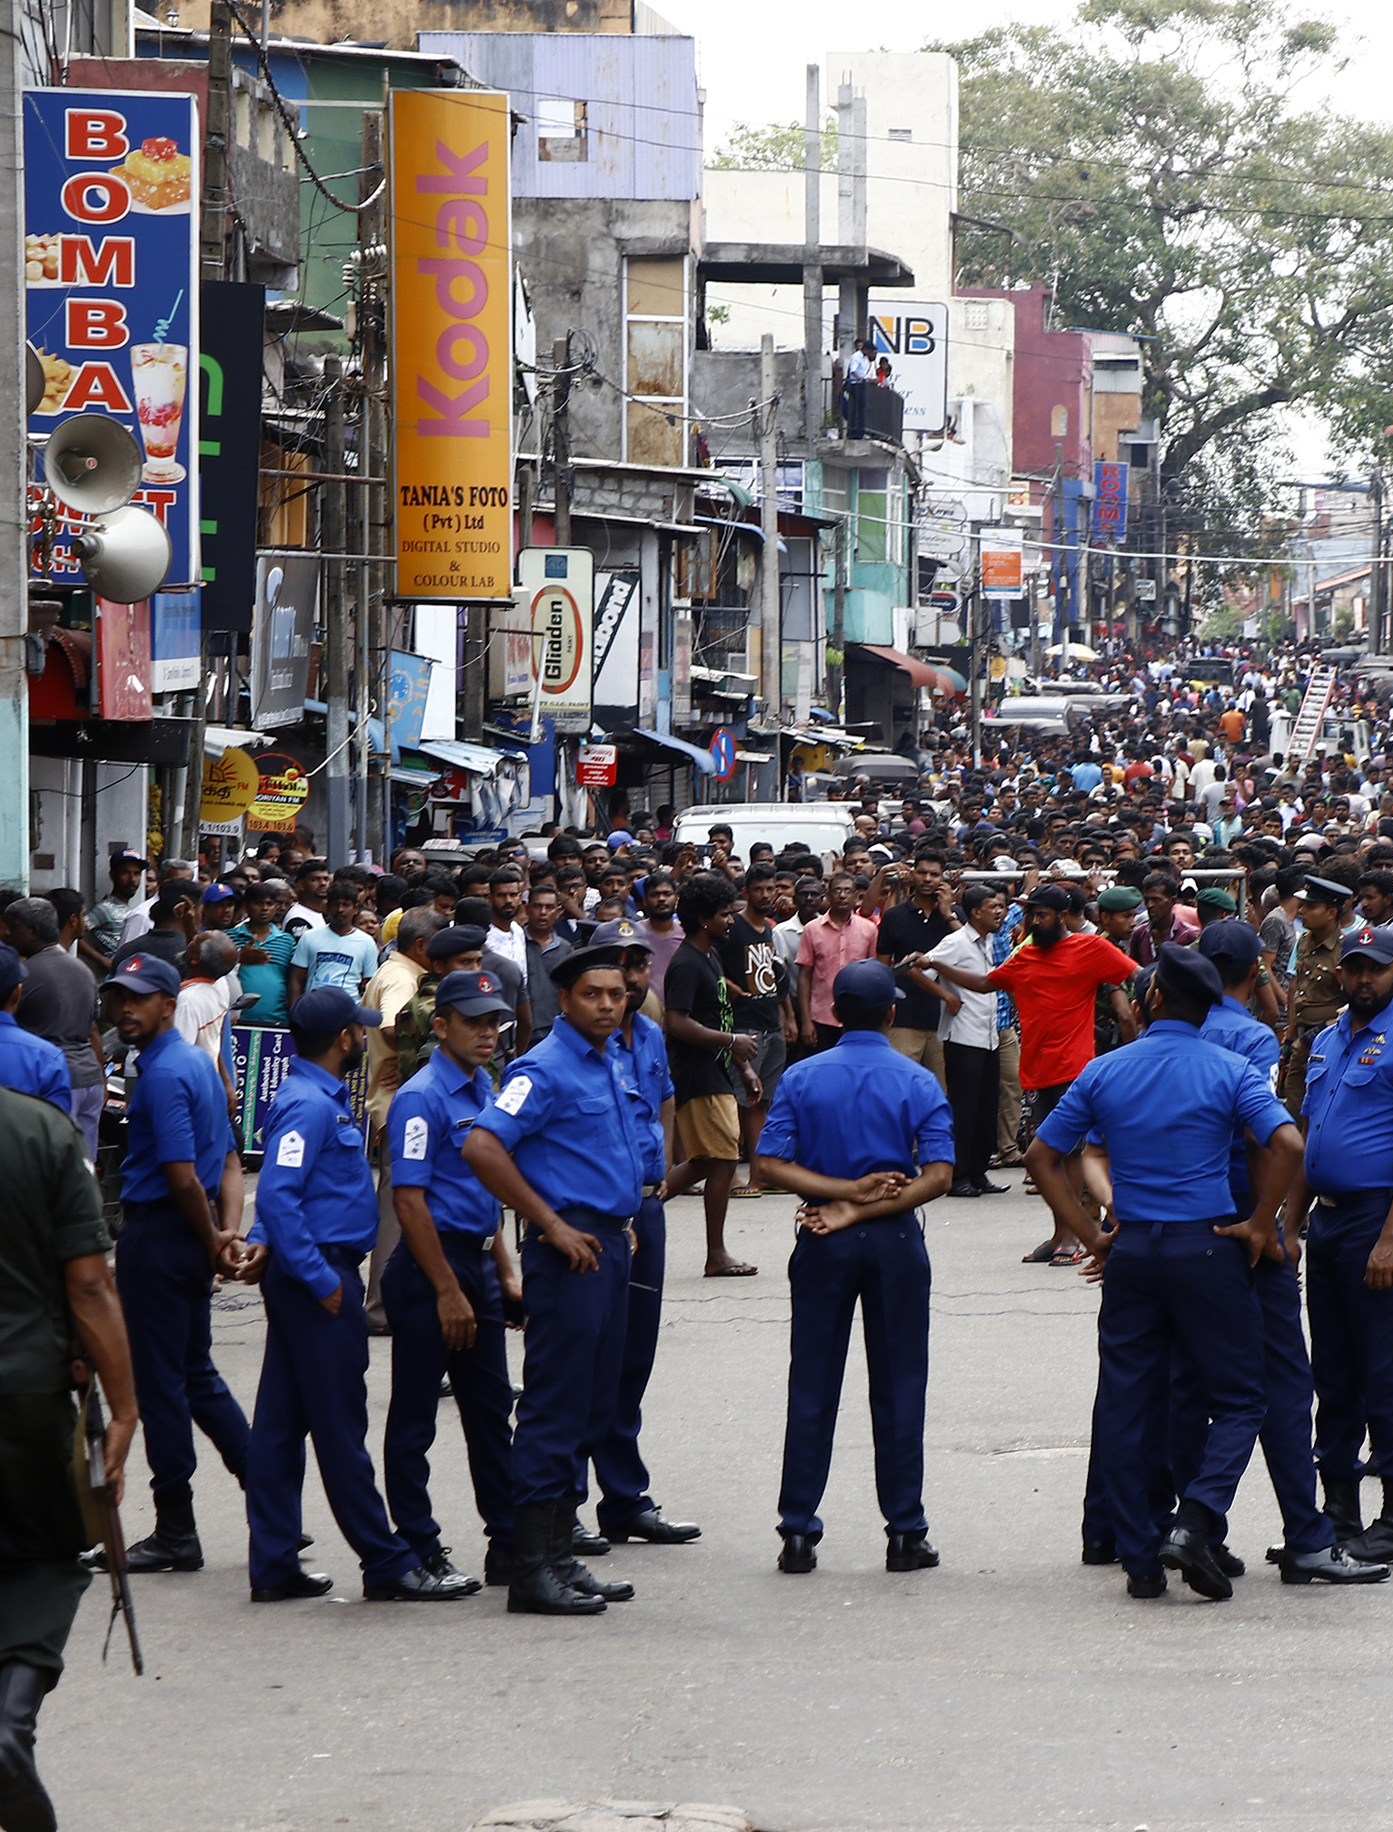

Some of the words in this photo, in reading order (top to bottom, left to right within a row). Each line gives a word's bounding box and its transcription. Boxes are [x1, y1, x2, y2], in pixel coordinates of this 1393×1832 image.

[60, 107, 135, 430] BOMBA
[416, 138, 490, 438] Kodak
[401, 486, 464, 506] TANIA'S
[469, 486, 508, 507] FOTO
[465, 514, 484, 530] Ltd
[402, 541, 451, 553] DIGITAL
[455, 541, 501, 553] STUDIO
[449, 560, 460, 572] &
[414, 574, 467, 587] COLOUR
[471, 576, 495, 588] LAB
[545, 600, 563, 680] Glidden
[199, 822, 240, 835] 4.1/103.9
[317, 953, 353, 965] adidas
[273, 1034, 283, 1054] Card
